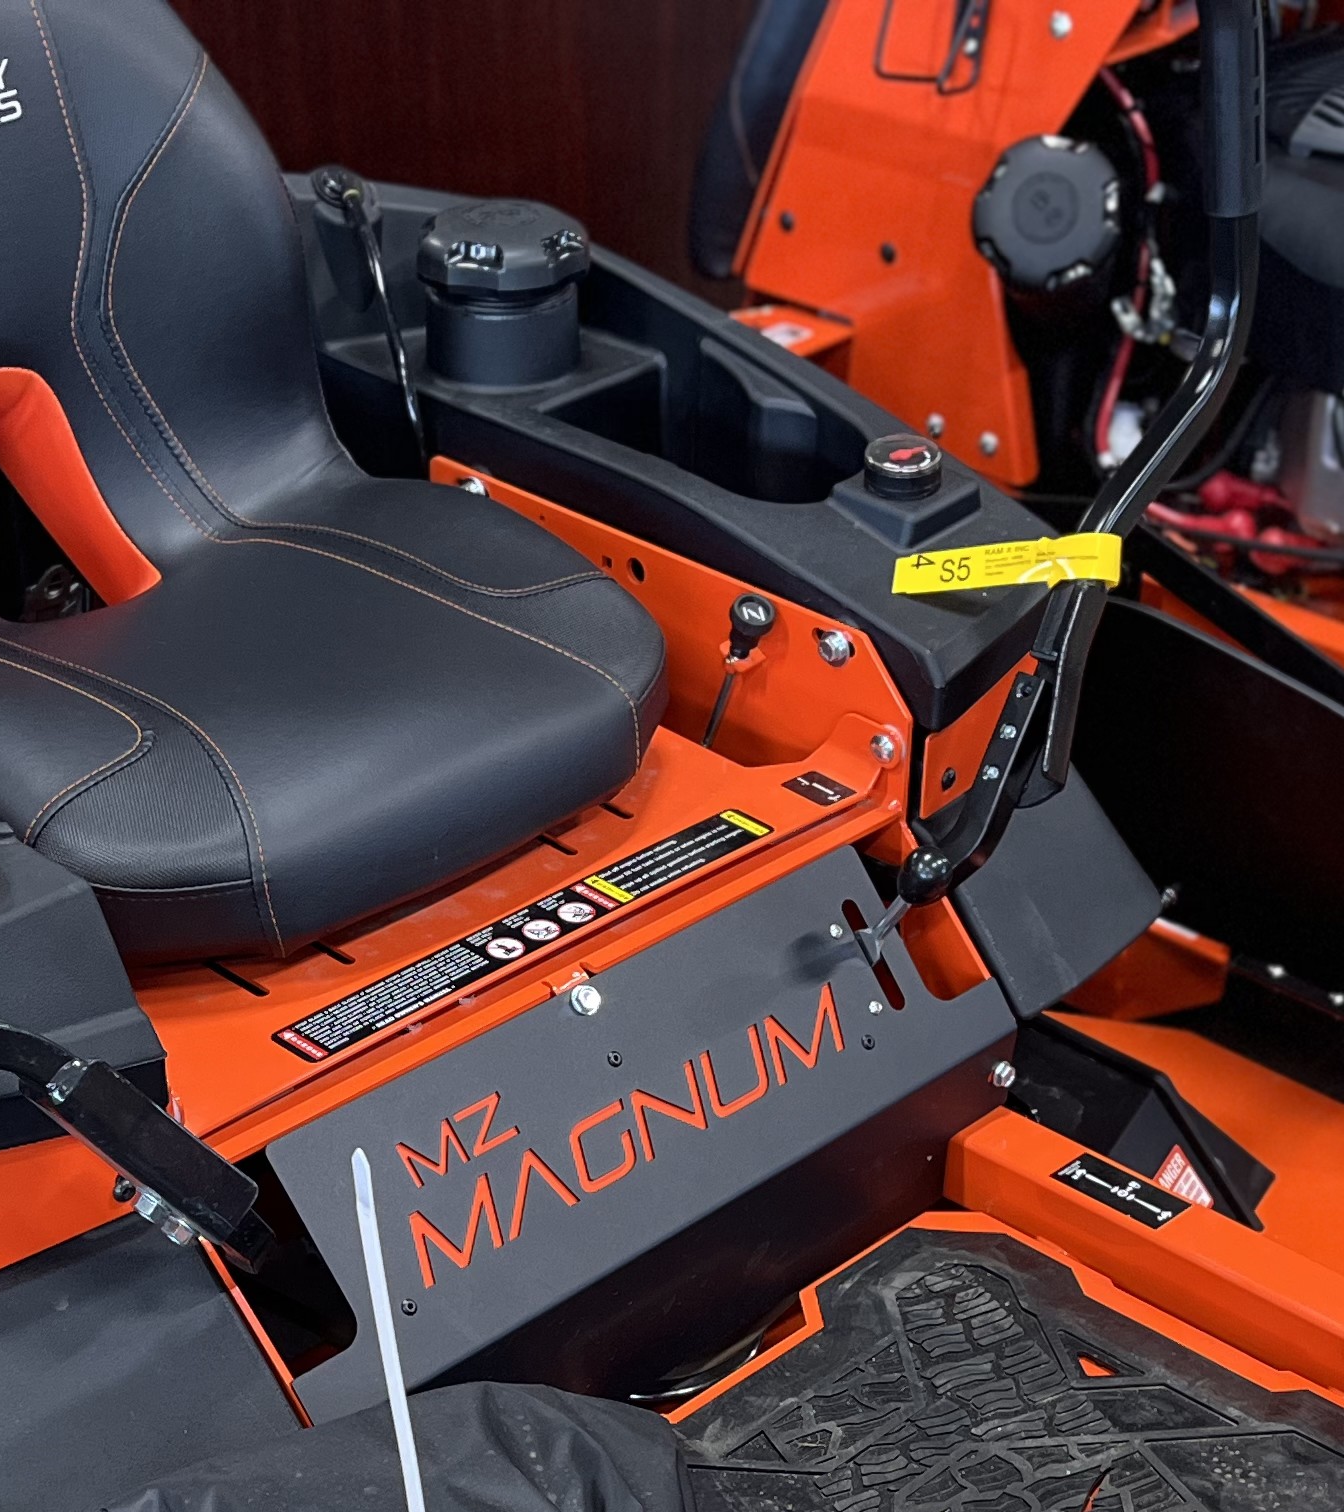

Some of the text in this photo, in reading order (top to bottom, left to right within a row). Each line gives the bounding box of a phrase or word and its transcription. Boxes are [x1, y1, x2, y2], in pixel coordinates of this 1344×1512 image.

[939, 556, 971, 583] S5
[395, 1092, 520, 1189] MZ
[407, 982, 846, 1290] MAGNUM
